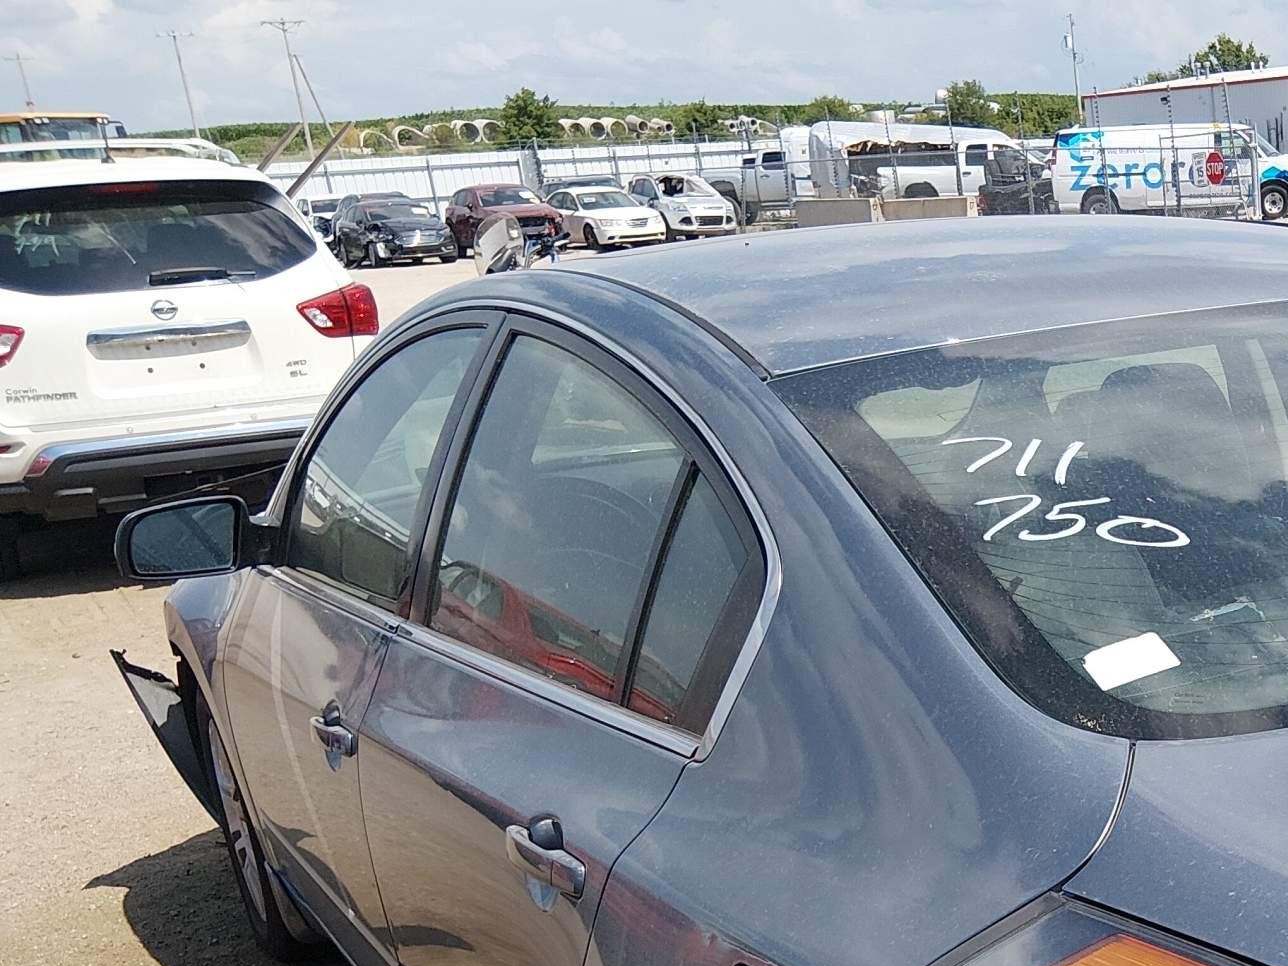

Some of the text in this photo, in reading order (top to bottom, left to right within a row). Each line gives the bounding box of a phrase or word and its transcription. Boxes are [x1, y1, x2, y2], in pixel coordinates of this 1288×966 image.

[1197, 166, 1204, 178] 15
[1206, 162, 1224, 176] STOP
[289, 369, 308, 378] SL
[5, 391, 79, 404] PATHFINDER
[942, 437, 1085, 486] 711
[974, 494, 1191, 548] 750
